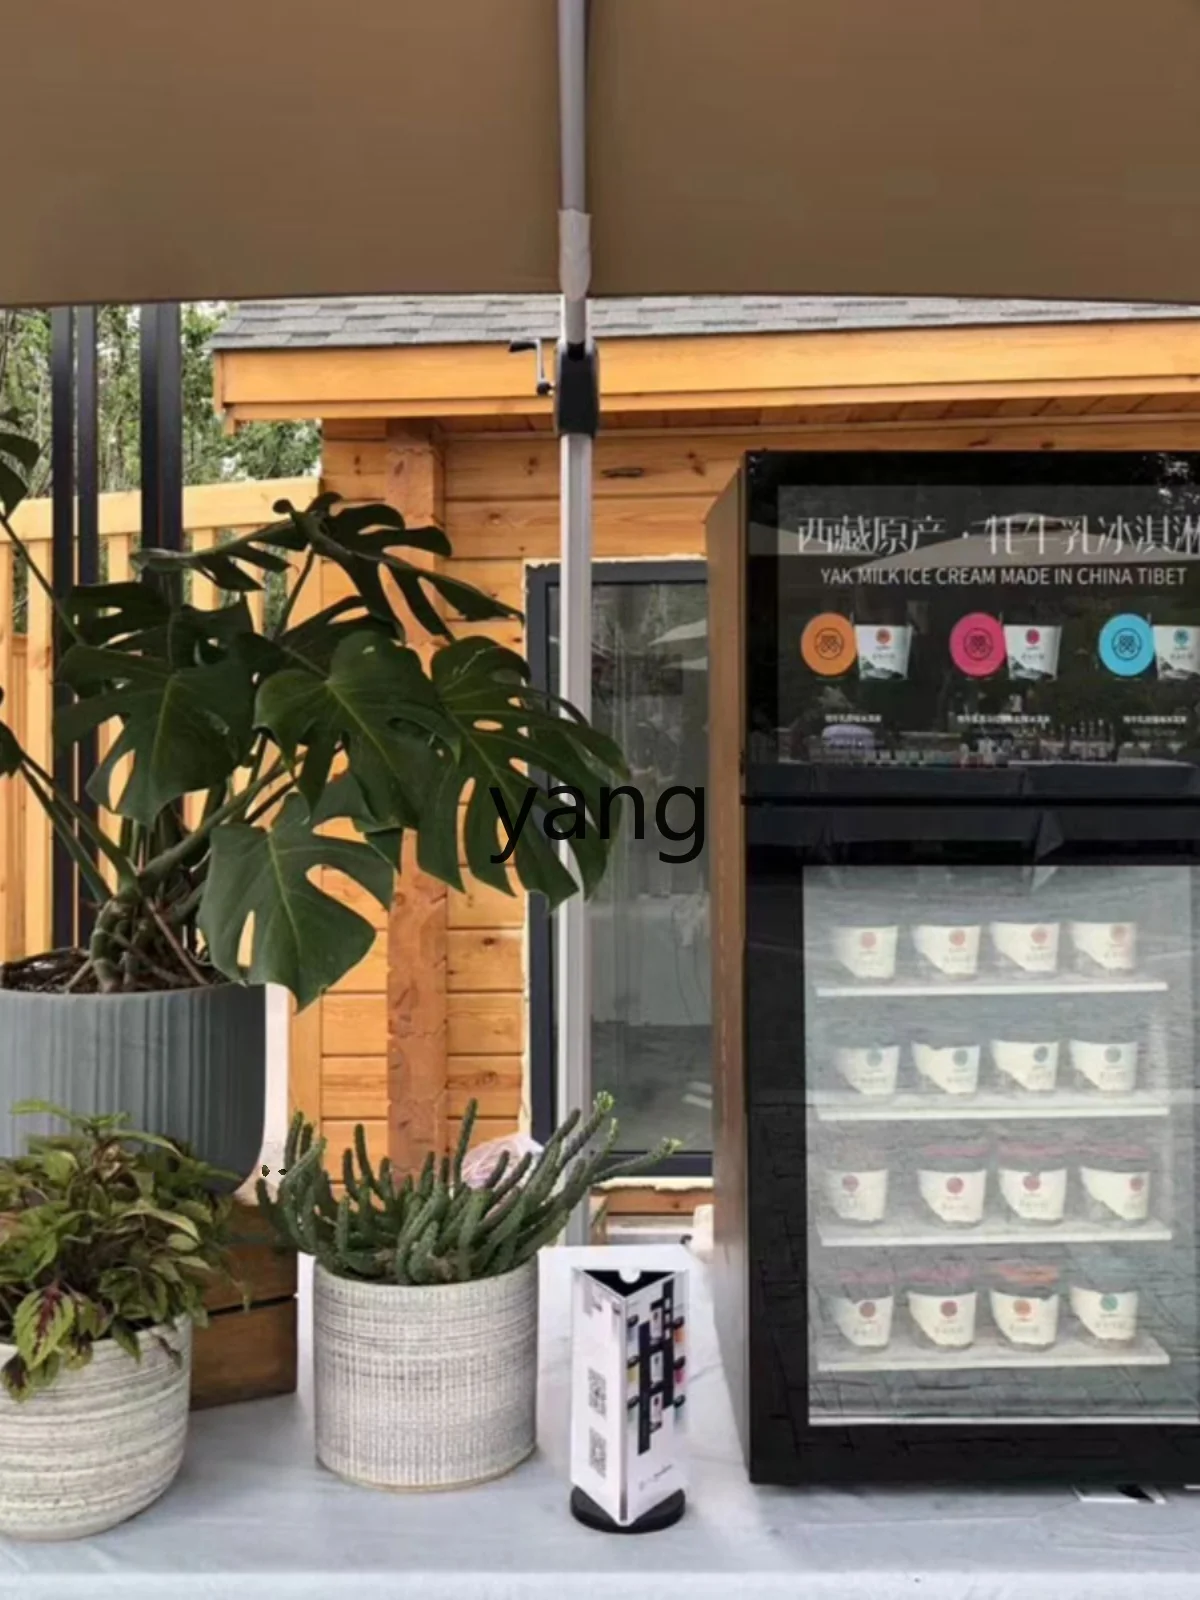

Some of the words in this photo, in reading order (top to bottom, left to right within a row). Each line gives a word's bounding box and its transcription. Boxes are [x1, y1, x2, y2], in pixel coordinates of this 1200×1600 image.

[820, 567, 852, 585] YAK
[857, 567, 900, 585] MILK
[903, 567, 932, 585] ICE
[935, 567, 997, 585] CREAM
[1000, 567, 1051, 585] MADE
[1054, 567, 1075, 585] IN
[1076, 567, 1133, 585] CHINA
[1136, 567, 1187, 585] TIBET
